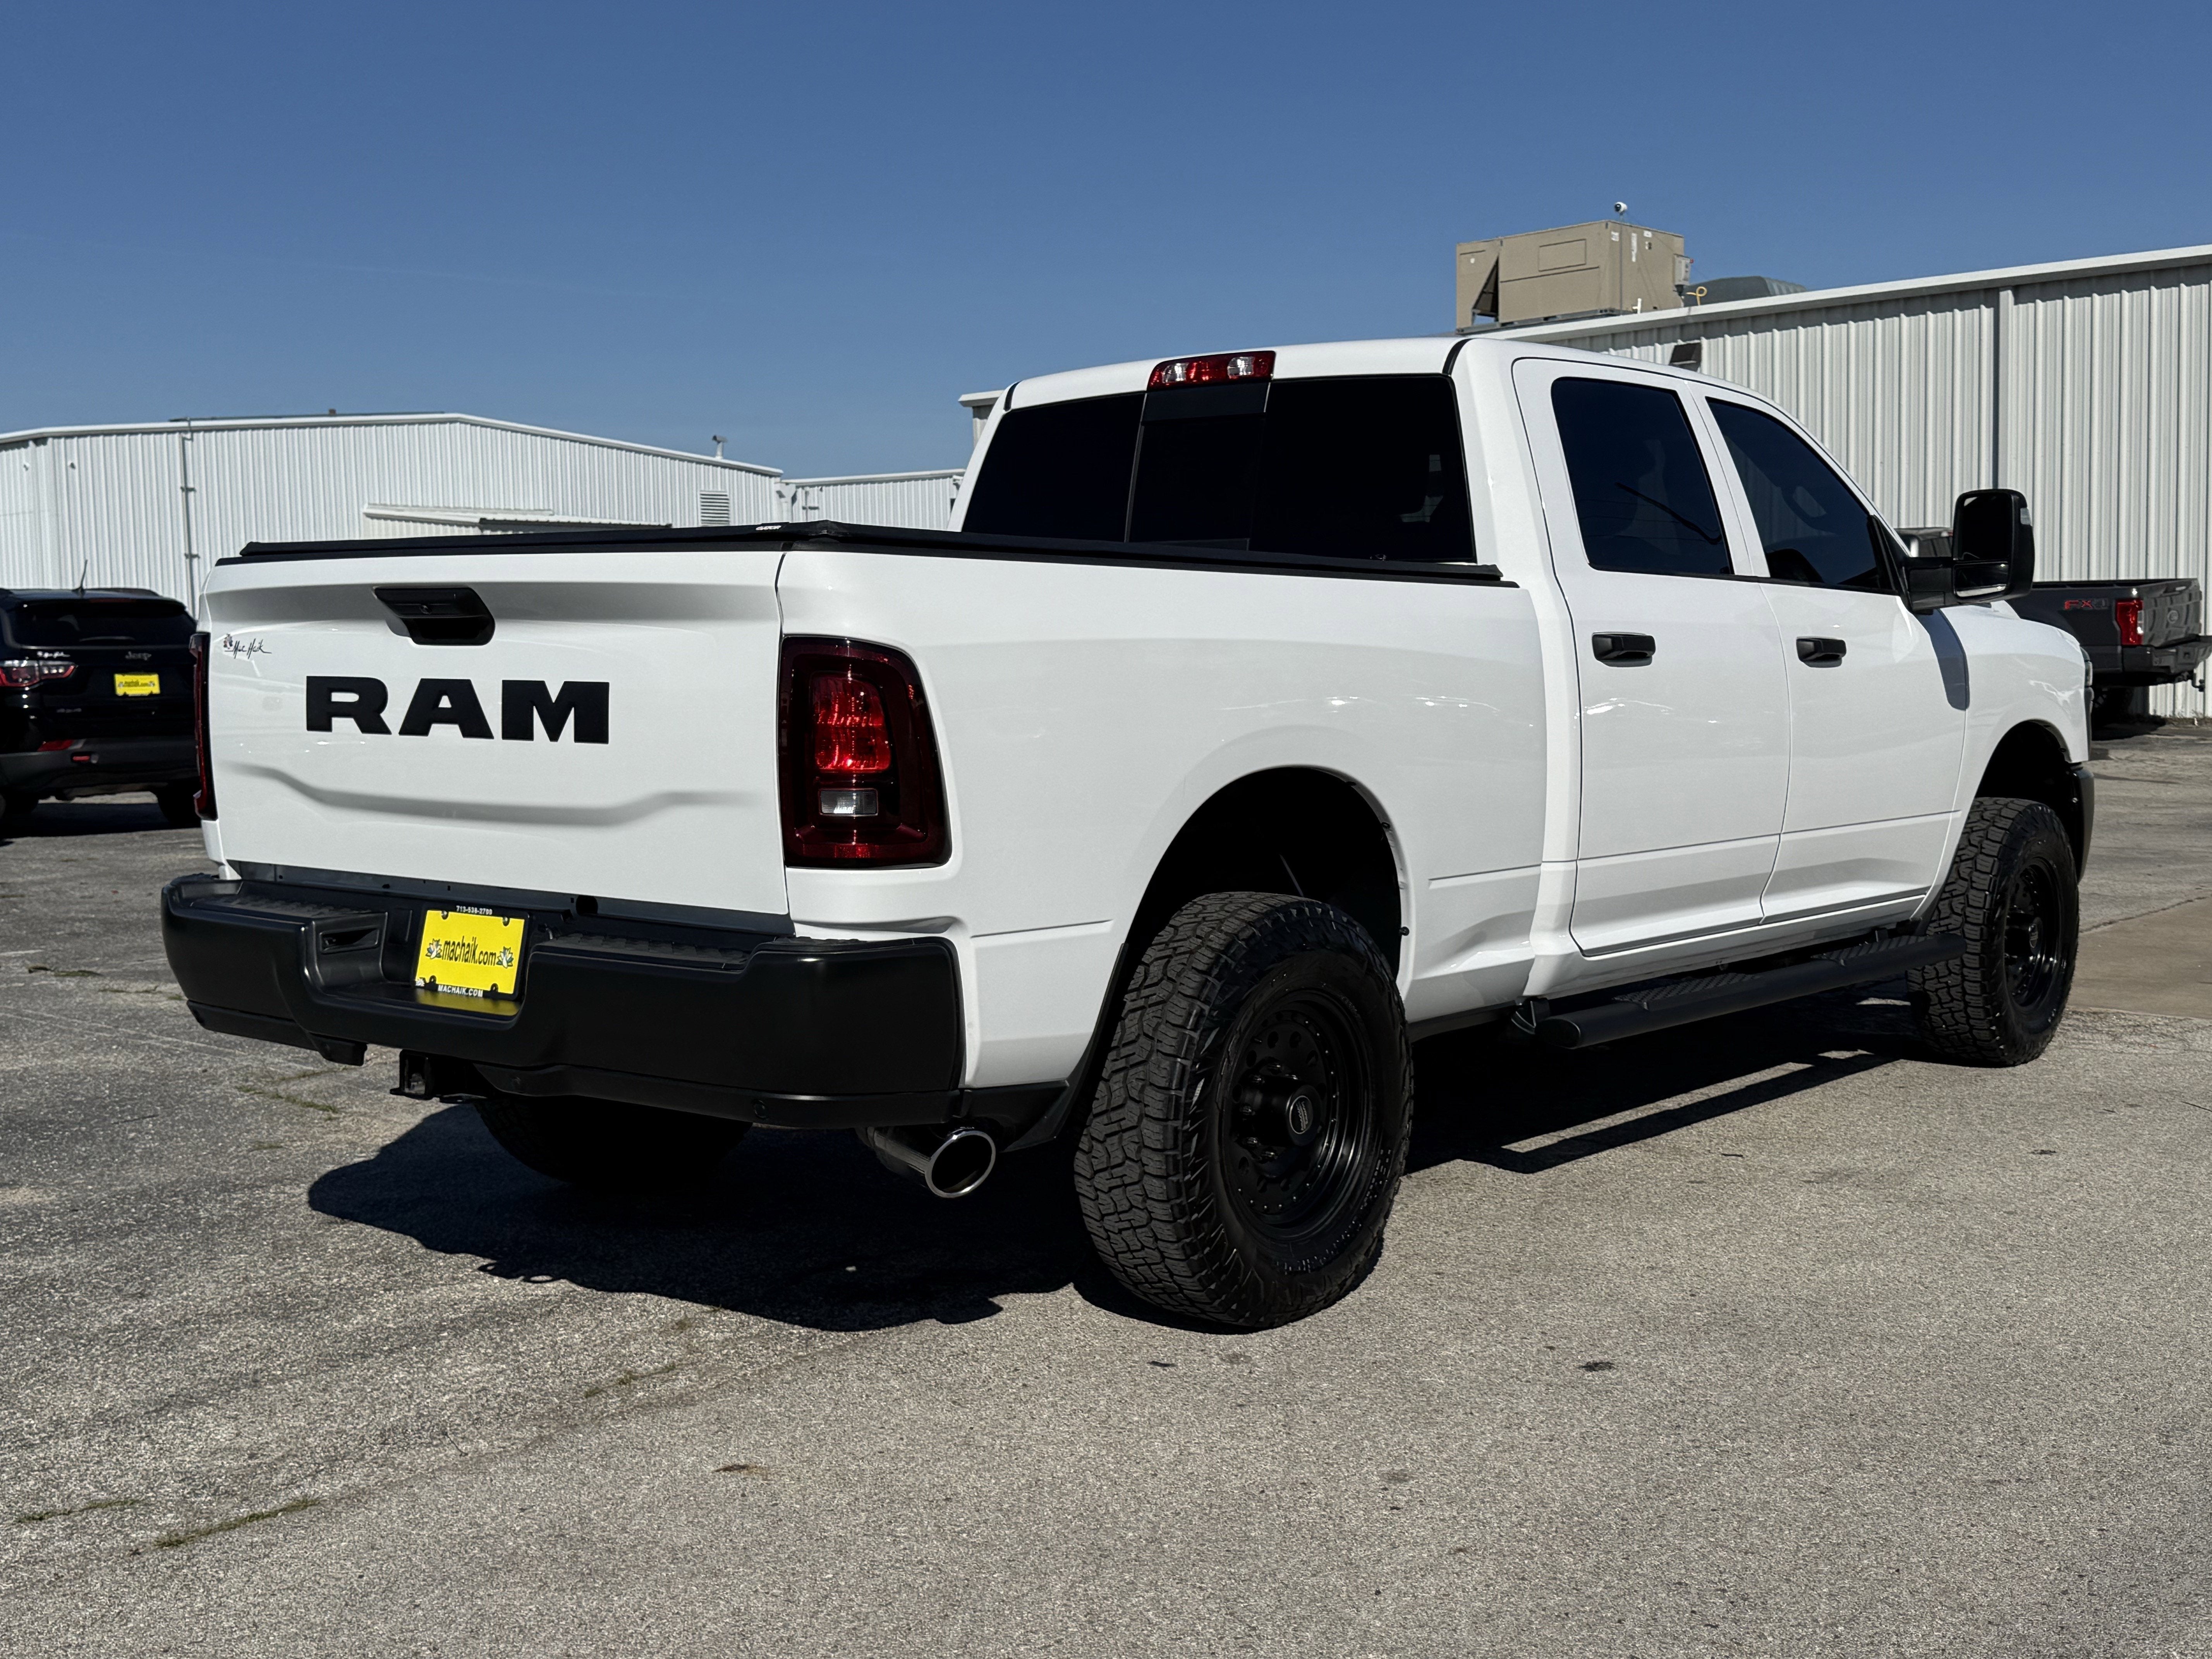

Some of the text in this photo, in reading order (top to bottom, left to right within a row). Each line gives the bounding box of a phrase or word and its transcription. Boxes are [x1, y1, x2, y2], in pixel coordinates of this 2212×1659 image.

[306, 676, 610, 744] RAM
[442, 936, 496, 966] machaik.com
[438, 985, 483, 997] MACHAIK.COM
